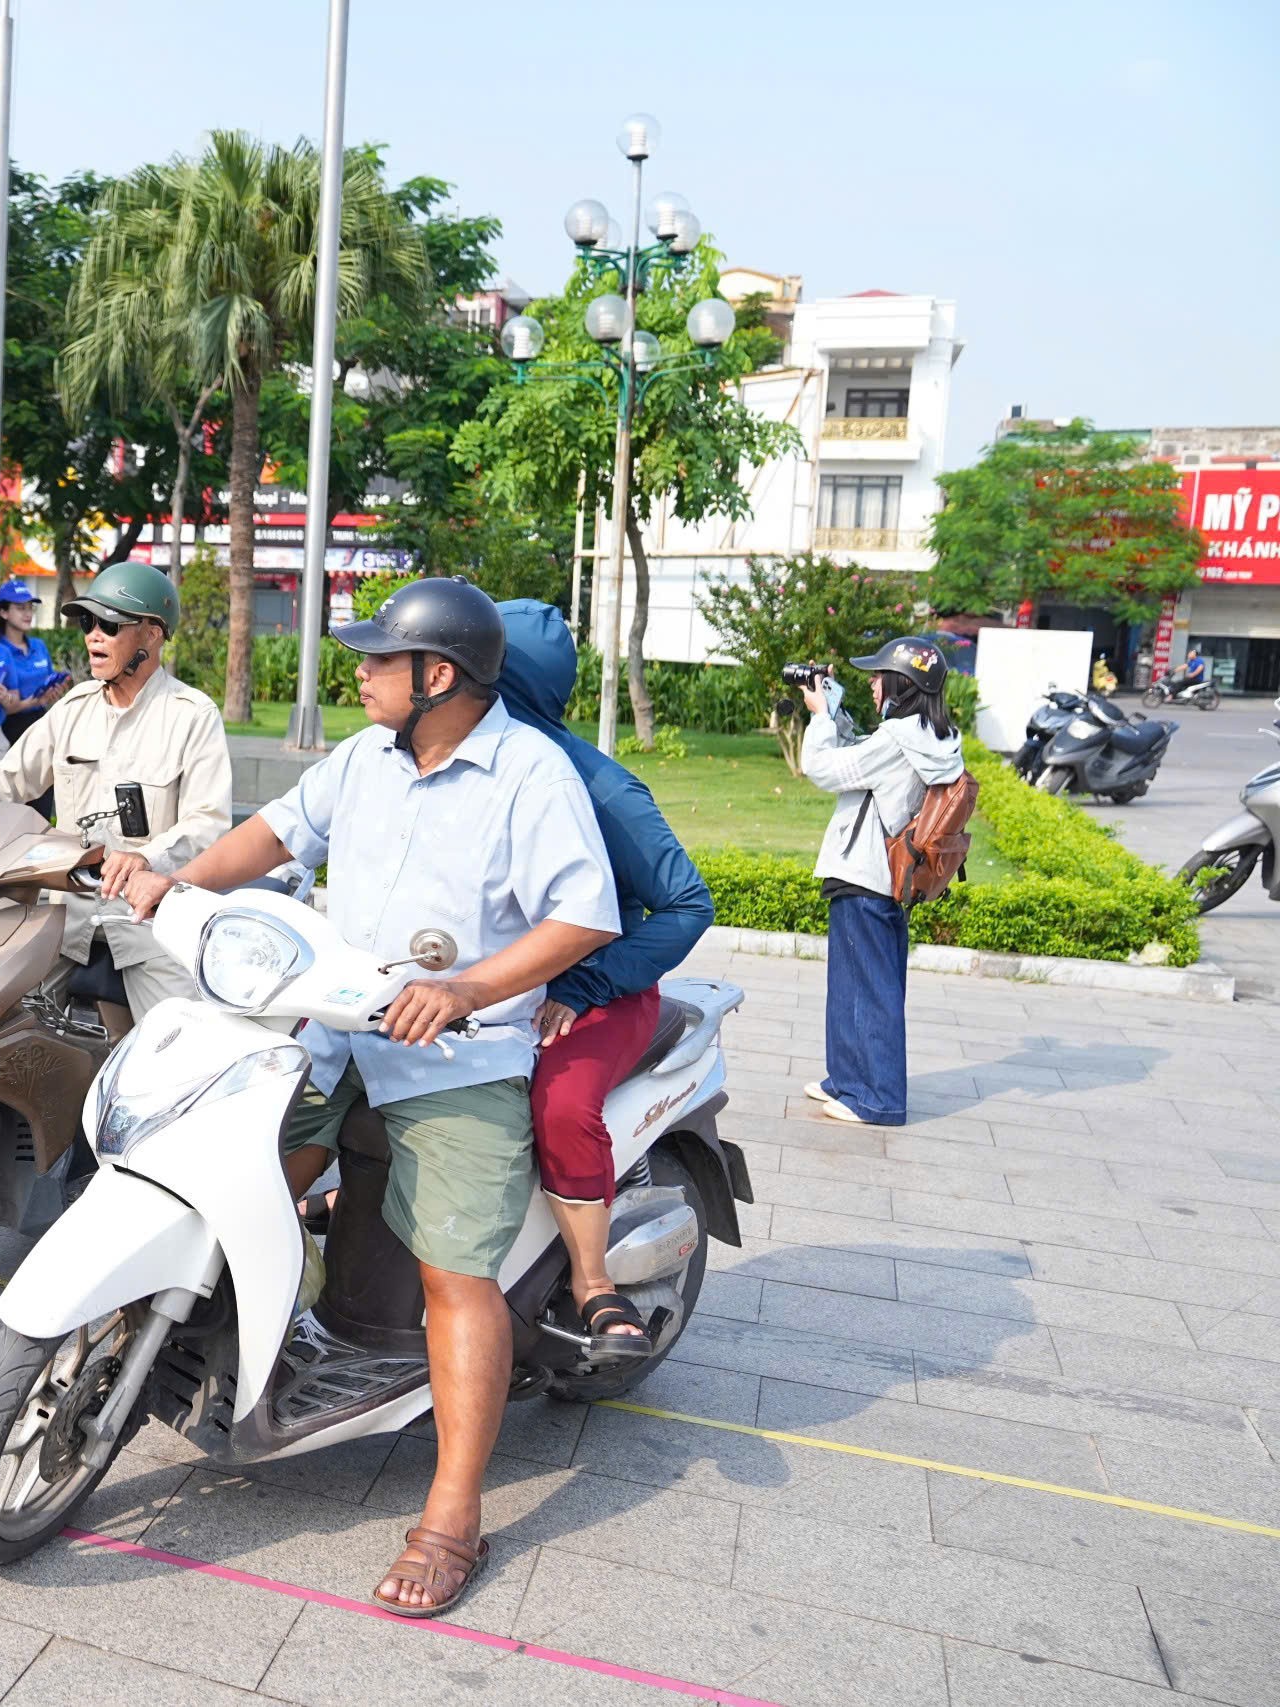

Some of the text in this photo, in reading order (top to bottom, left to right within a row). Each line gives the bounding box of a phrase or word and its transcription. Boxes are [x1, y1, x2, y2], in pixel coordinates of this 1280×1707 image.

[1202, 487, 1280, 531] MỸ P
[254, 529, 305, 541] SAMSUNG
